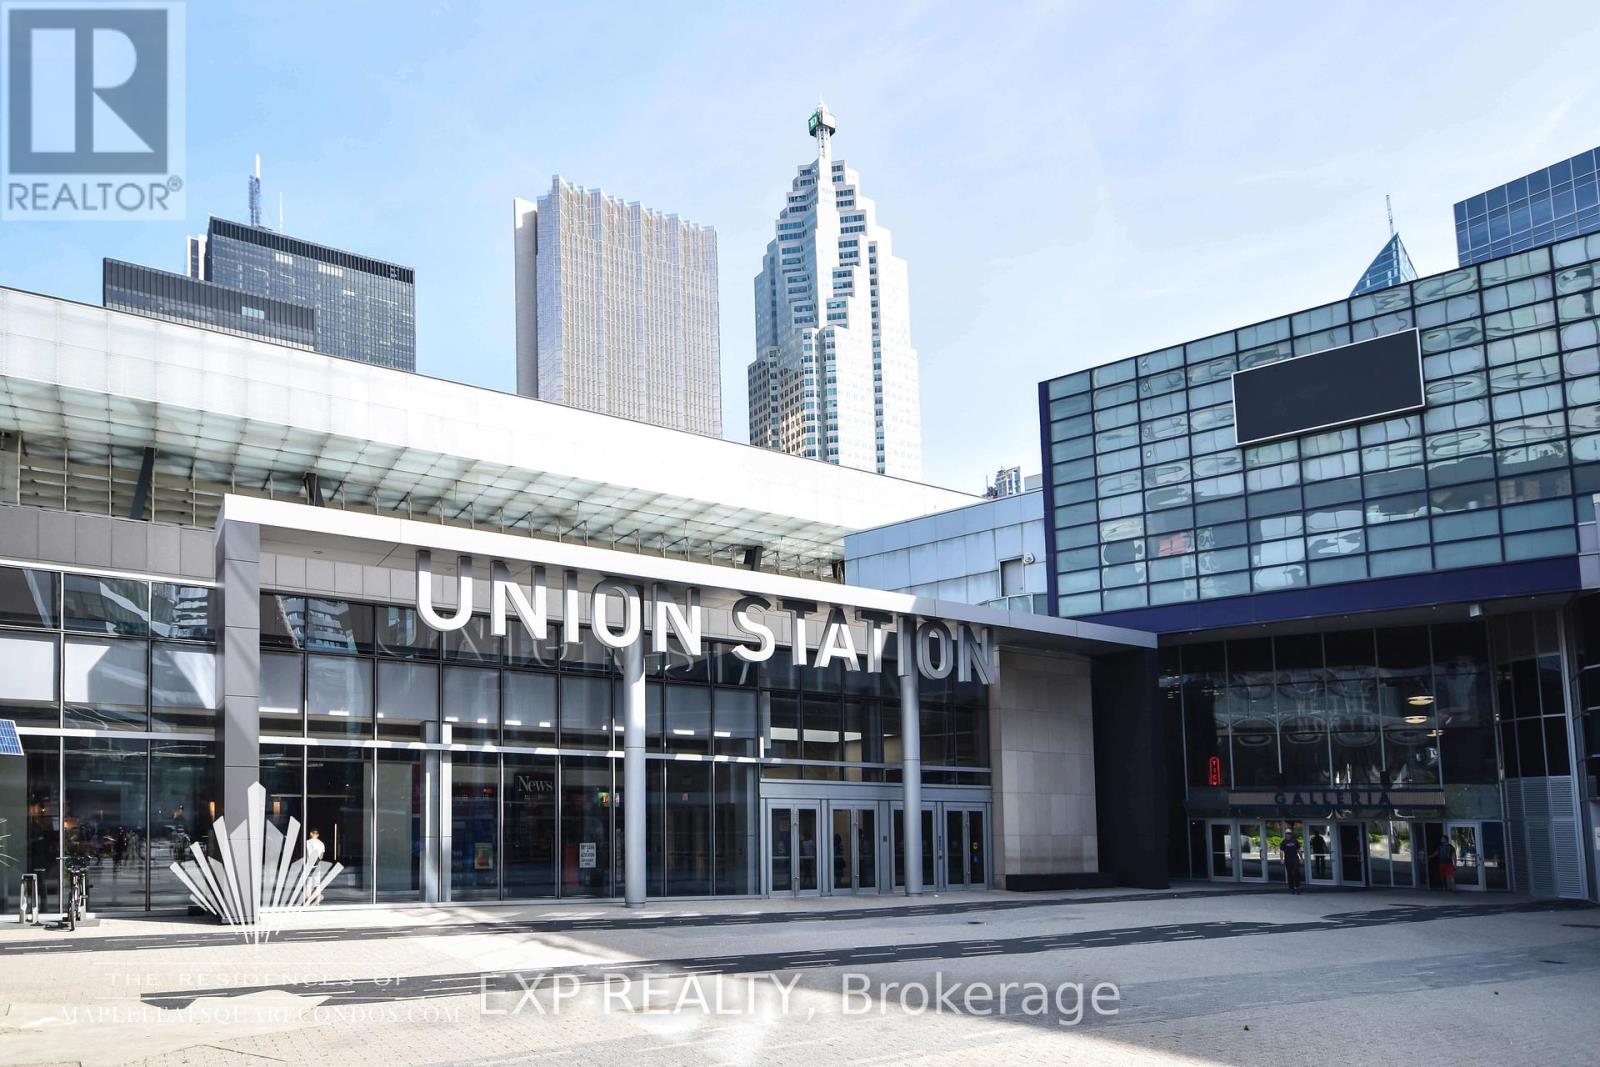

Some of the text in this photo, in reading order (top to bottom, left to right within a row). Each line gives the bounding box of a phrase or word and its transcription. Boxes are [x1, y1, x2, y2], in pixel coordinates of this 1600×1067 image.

[416, 550, 995, 685] UNION STATION
[517, 775, 553, 793] News
[1275, 791, 1391, 807] GALLERIA
